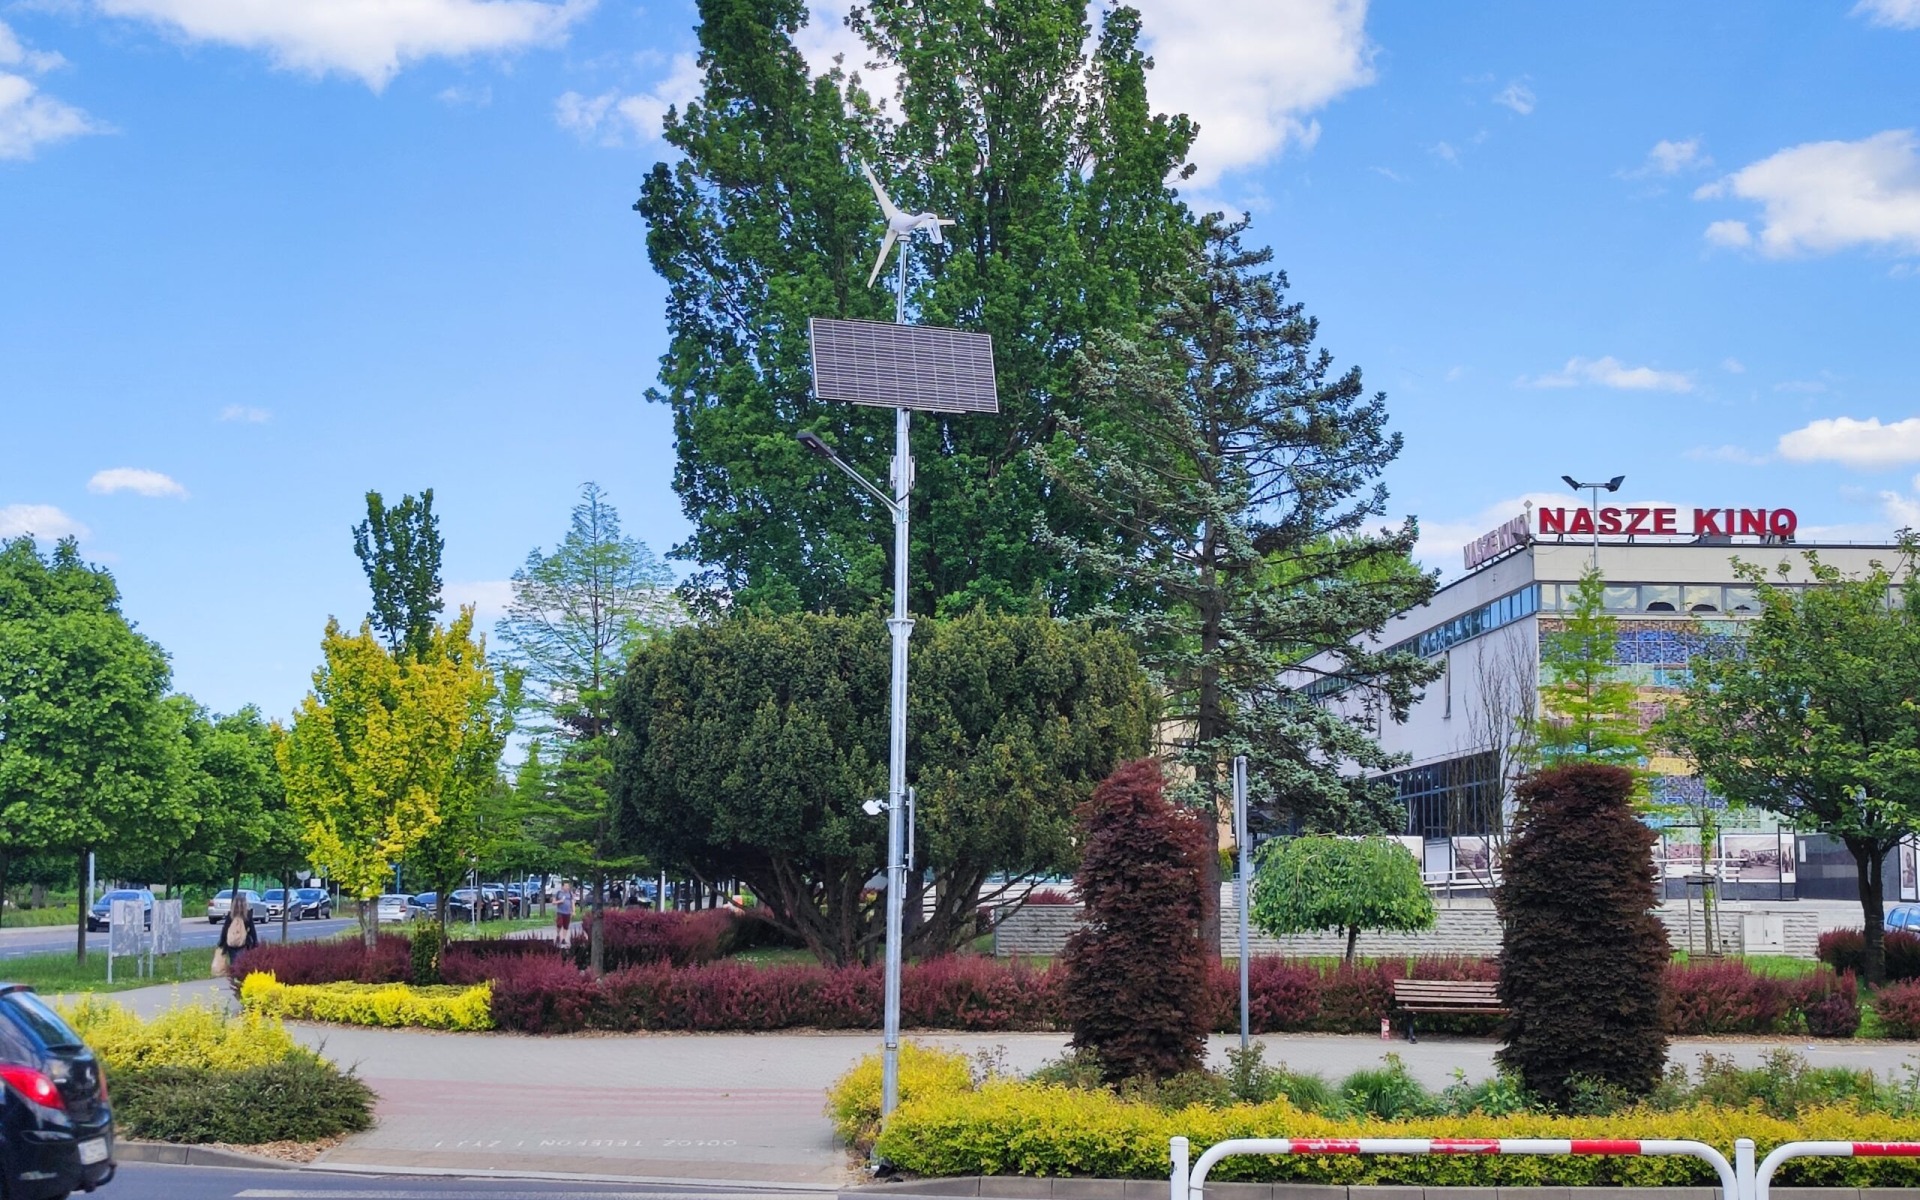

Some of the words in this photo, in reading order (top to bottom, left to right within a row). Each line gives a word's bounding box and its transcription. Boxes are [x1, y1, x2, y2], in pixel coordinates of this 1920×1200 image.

[1539, 507, 1676, 534] NASZE
[1693, 508, 1798, 536] KINO
[540, 1139, 644, 1147] TELEFON
